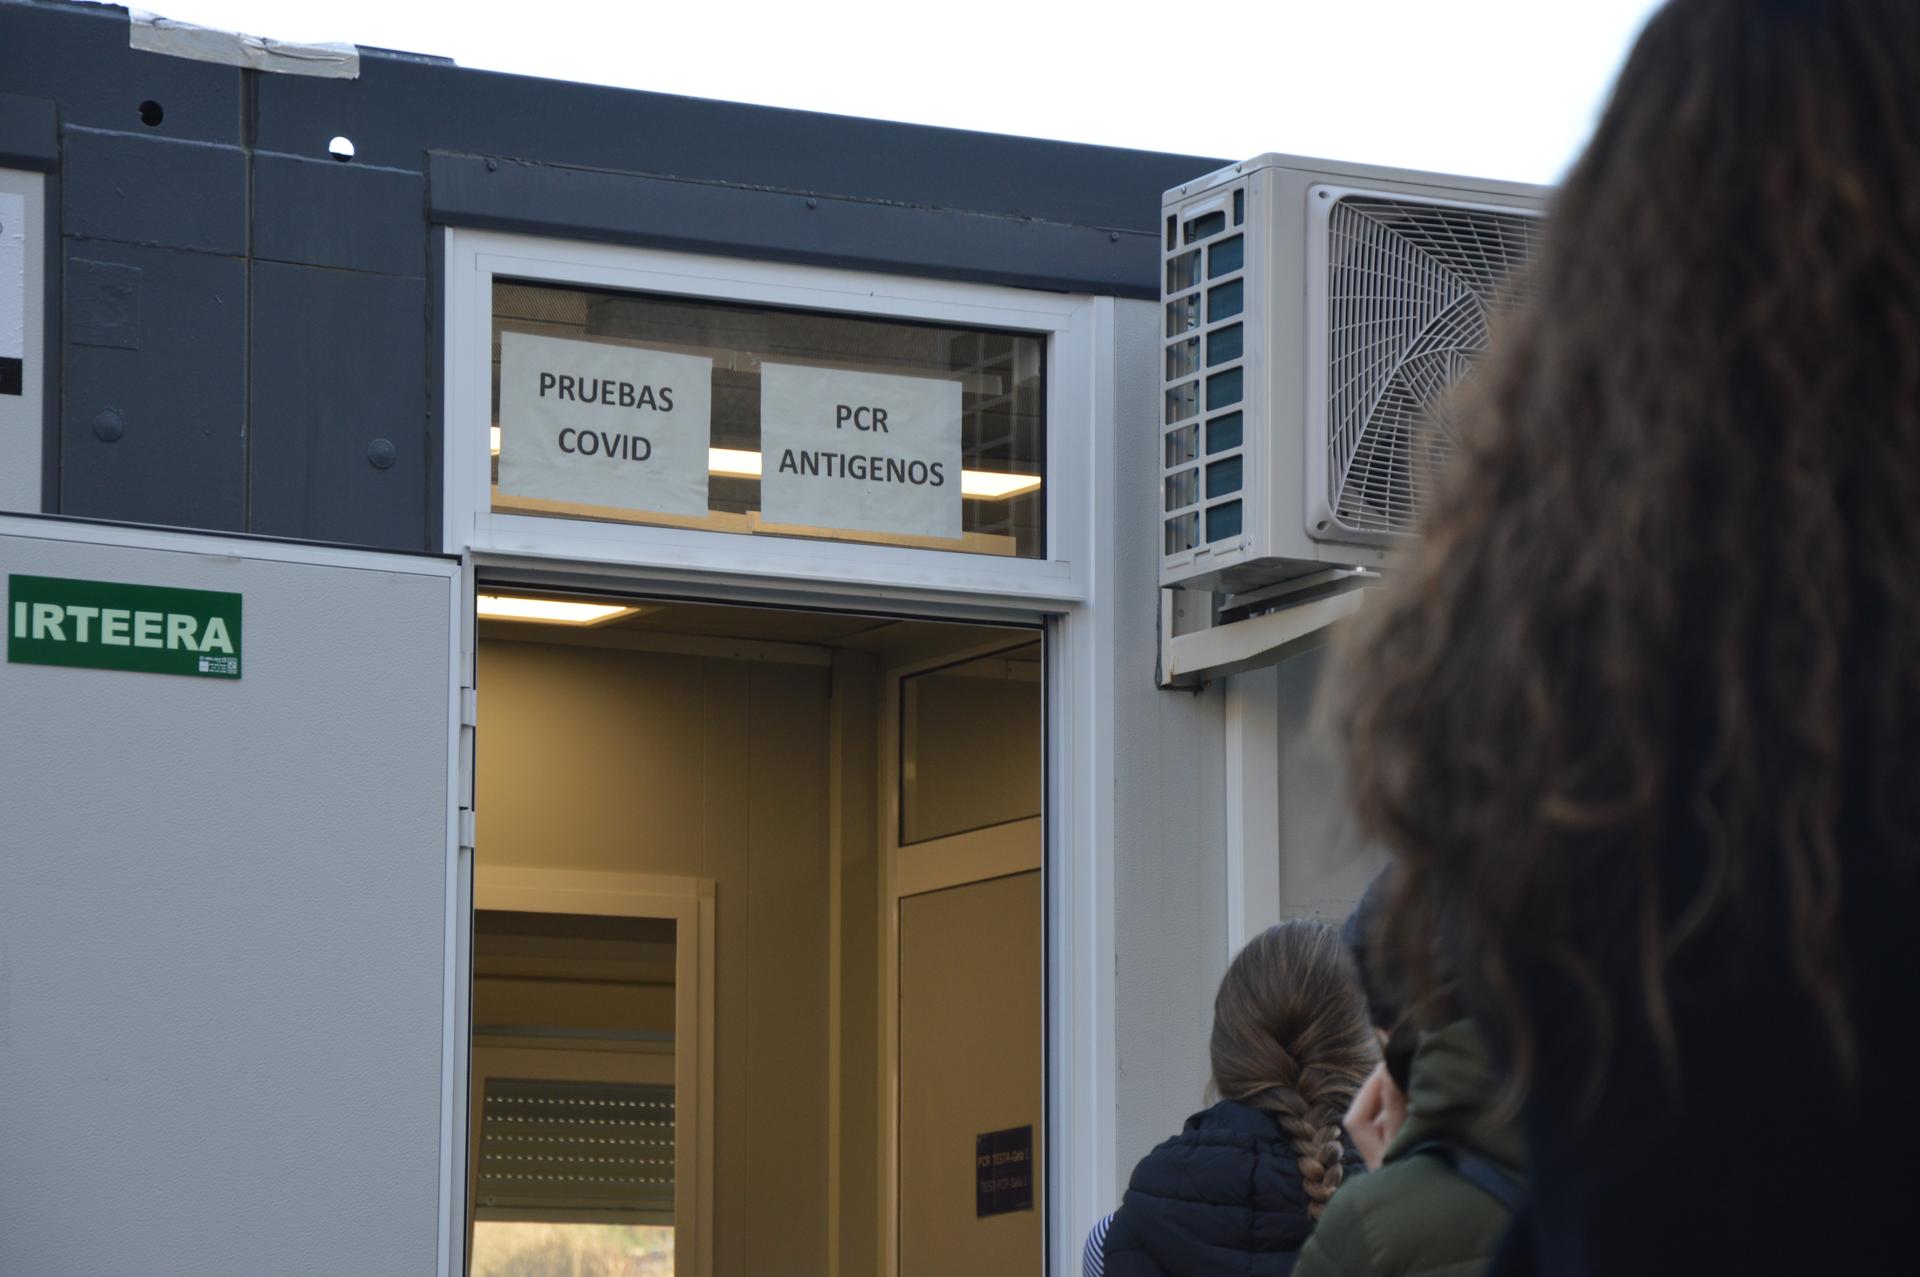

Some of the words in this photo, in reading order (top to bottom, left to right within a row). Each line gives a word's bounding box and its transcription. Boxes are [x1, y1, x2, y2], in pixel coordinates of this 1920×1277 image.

[539, 372, 674, 413] PRUEBAS
[835, 404, 889, 434] PCR
[558, 427, 652, 462] COVID
[778, 448, 945, 487] ANTIGENOS
[14, 601, 234, 654] IRTEERA
